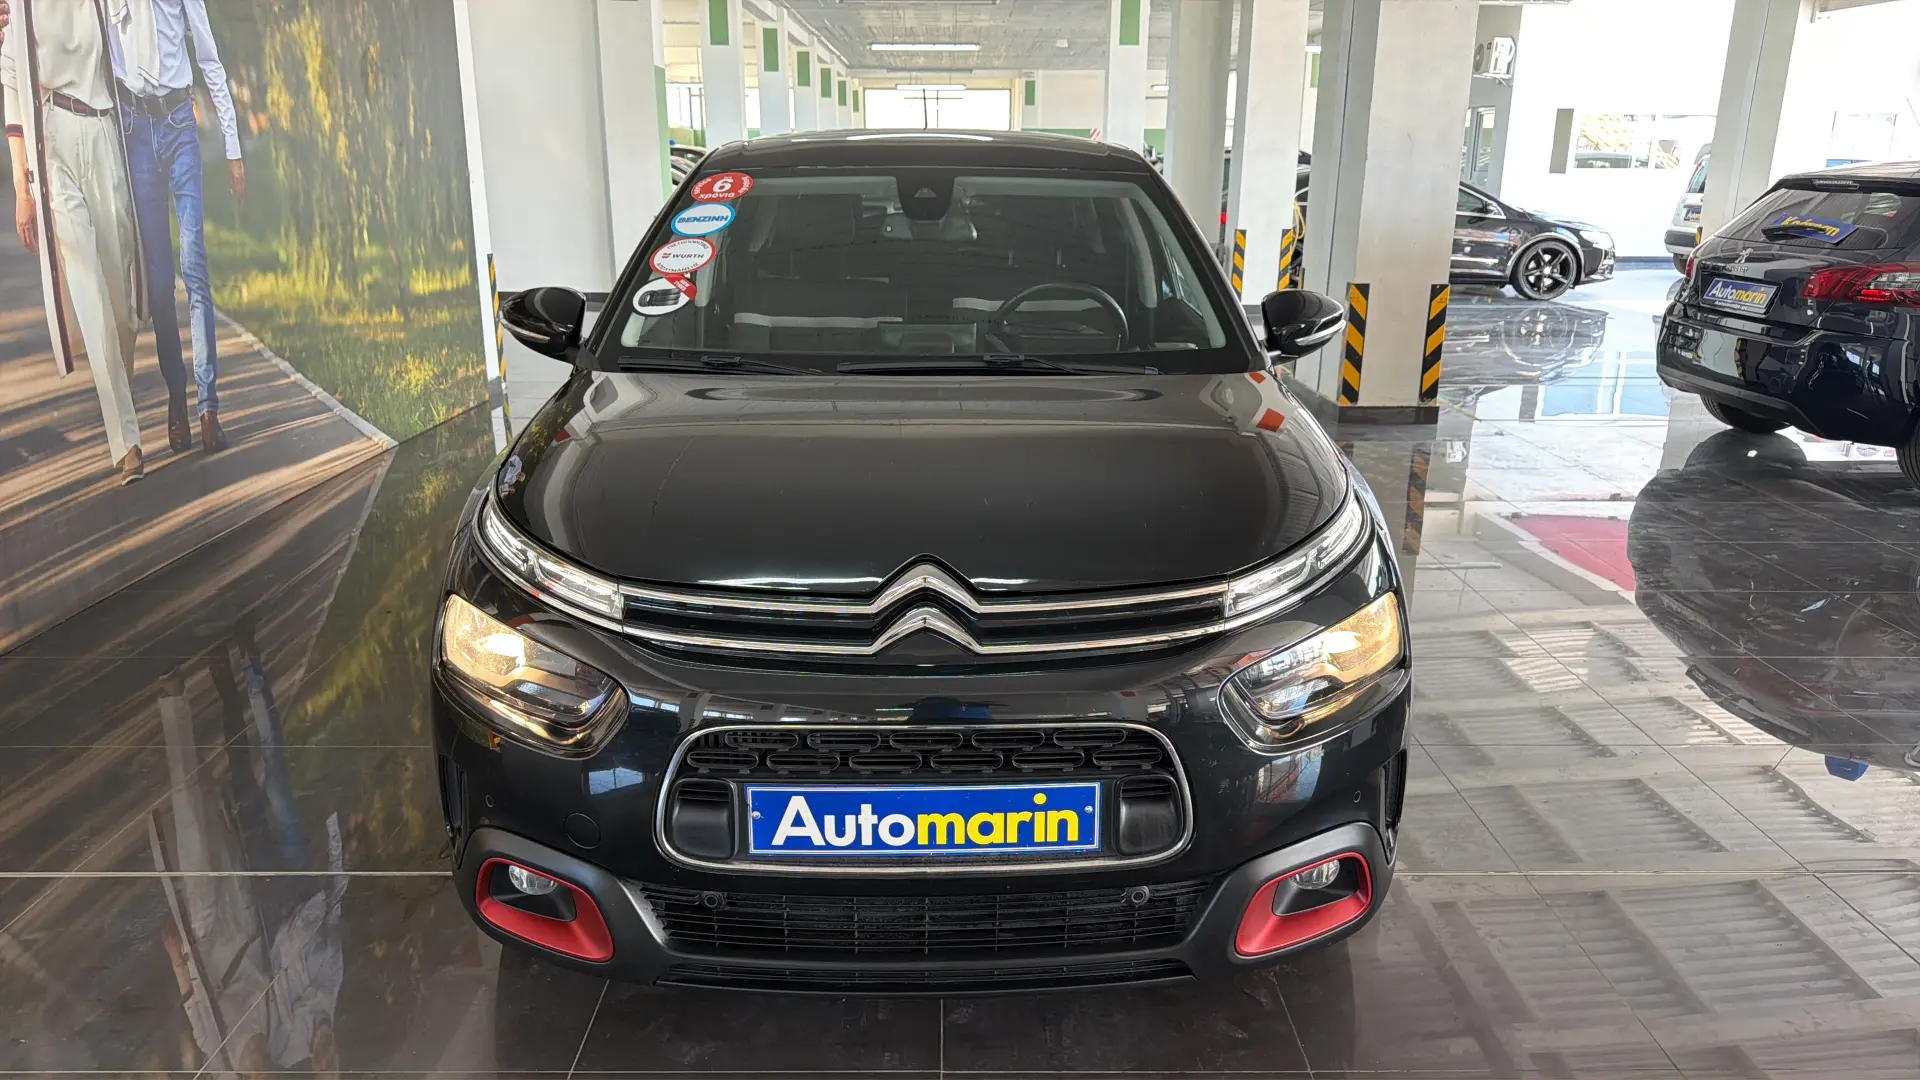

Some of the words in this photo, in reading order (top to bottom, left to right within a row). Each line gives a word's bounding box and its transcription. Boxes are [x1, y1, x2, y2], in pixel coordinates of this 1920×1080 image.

[713, 178, 734, 193] 6
[1709, 281, 1767, 304] Automarin
[771, 792, 1079, 847] Automarin
